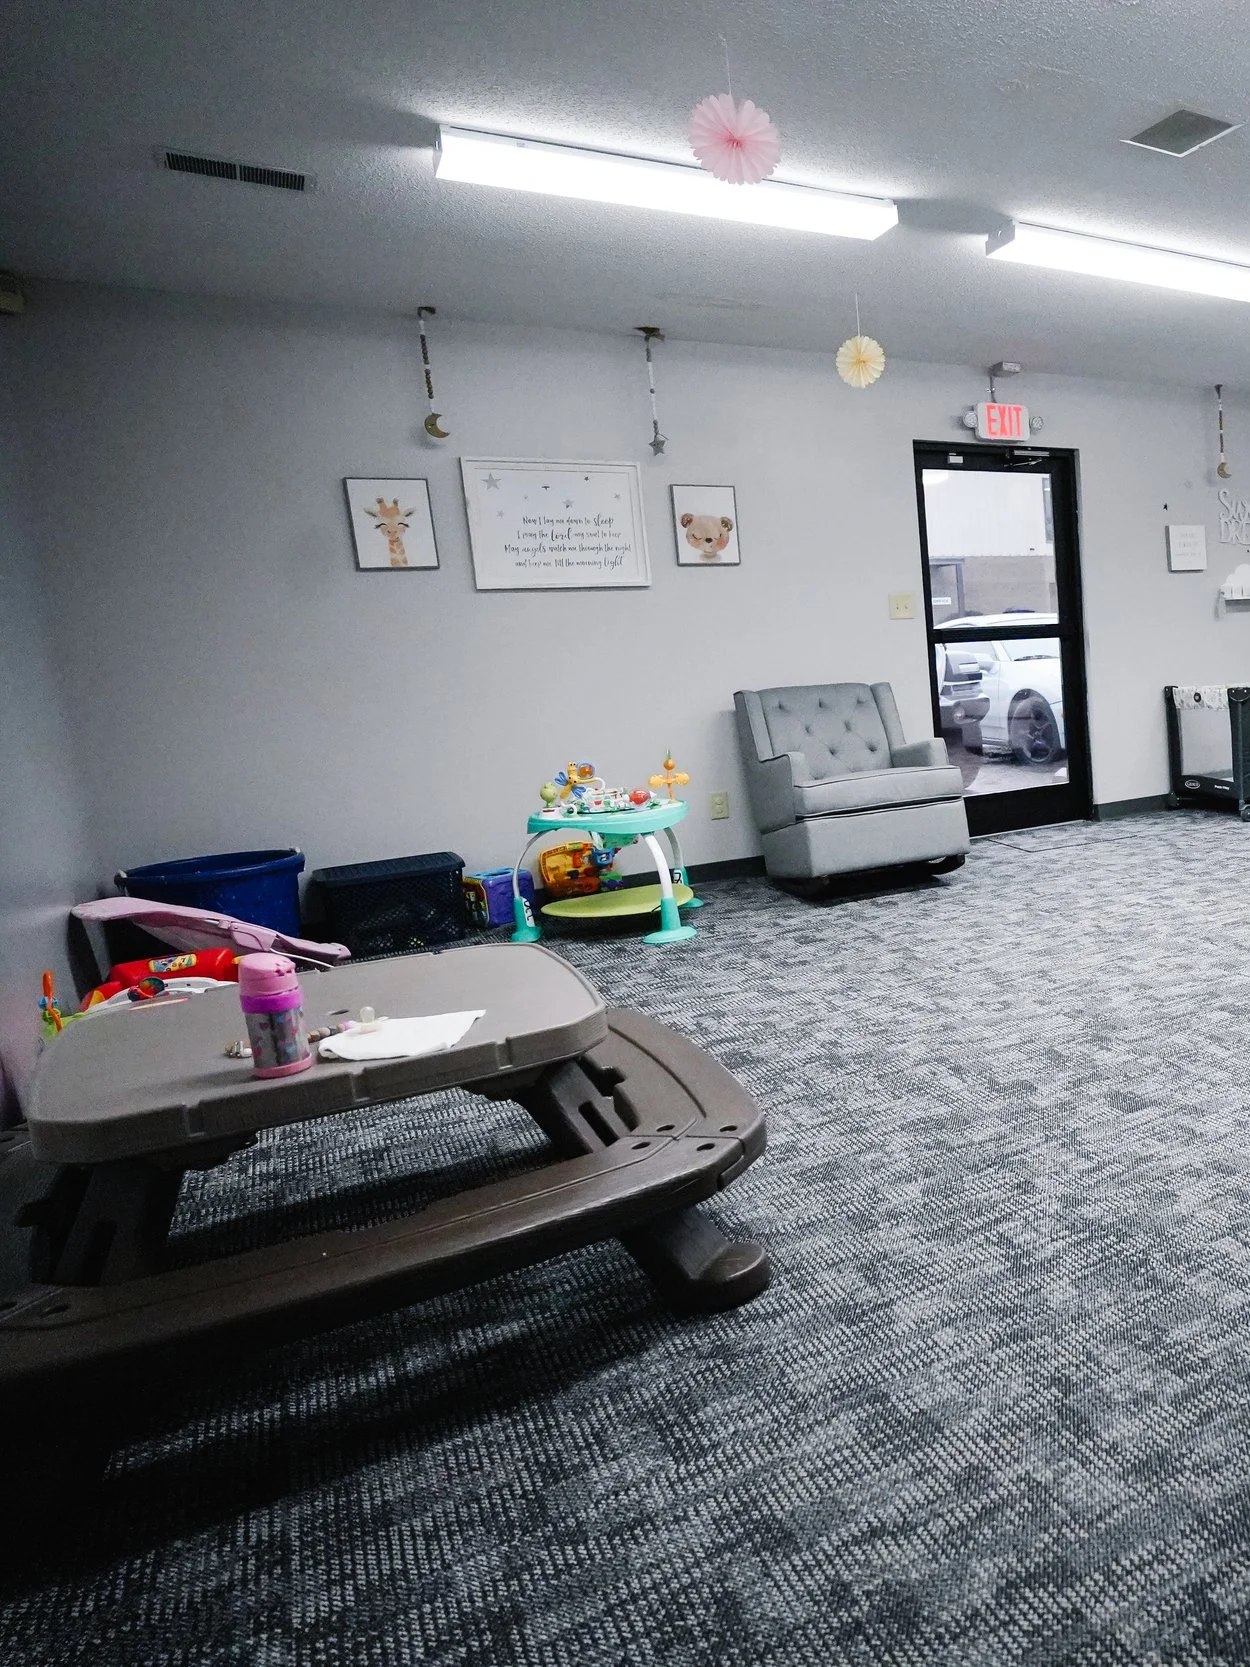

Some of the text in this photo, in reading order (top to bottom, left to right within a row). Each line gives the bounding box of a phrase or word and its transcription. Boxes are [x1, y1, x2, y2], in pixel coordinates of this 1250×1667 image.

[986, 404, 1022, 437] EXIT
[593, 514, 614, 528] sleep
[504, 543, 520, 556] May
[604, 543, 613, 552] the
